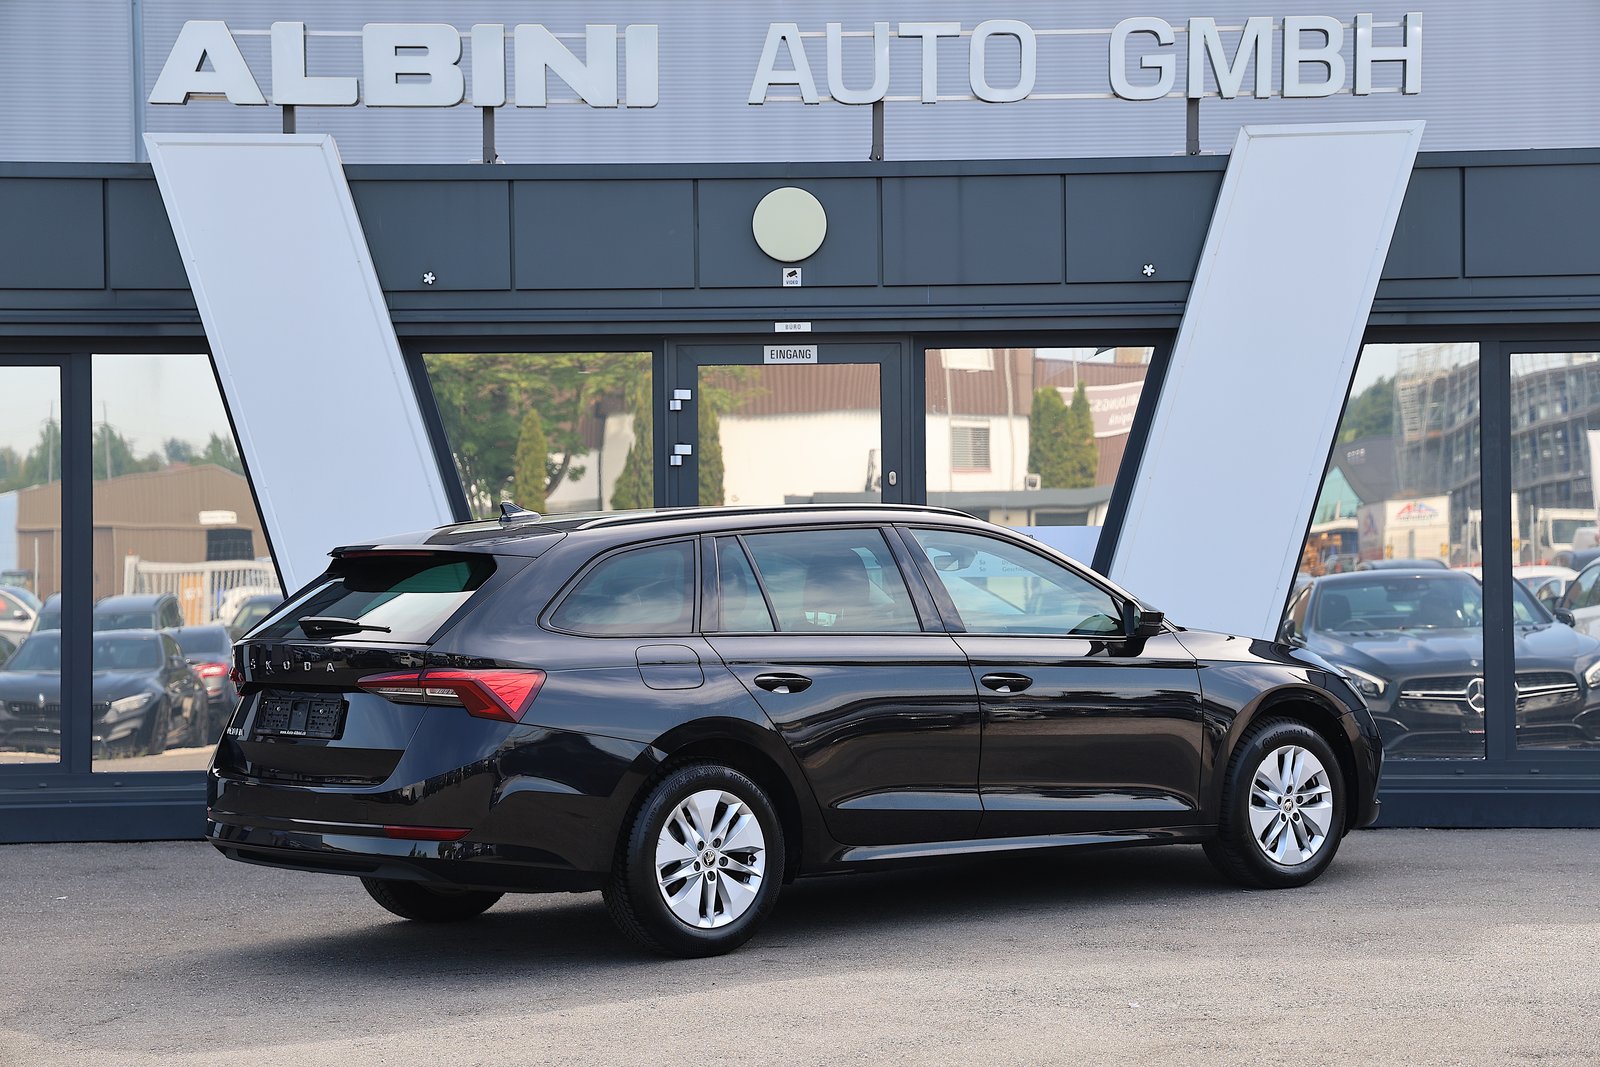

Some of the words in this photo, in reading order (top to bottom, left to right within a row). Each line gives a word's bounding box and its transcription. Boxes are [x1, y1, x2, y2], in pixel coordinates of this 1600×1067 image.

[148, 20, 659, 108] ALBINI
[748, 20, 1037, 105] AUTO
[1108, 12, 1423, 101] GMBH
[770, 349, 812, 360] EINGANG
